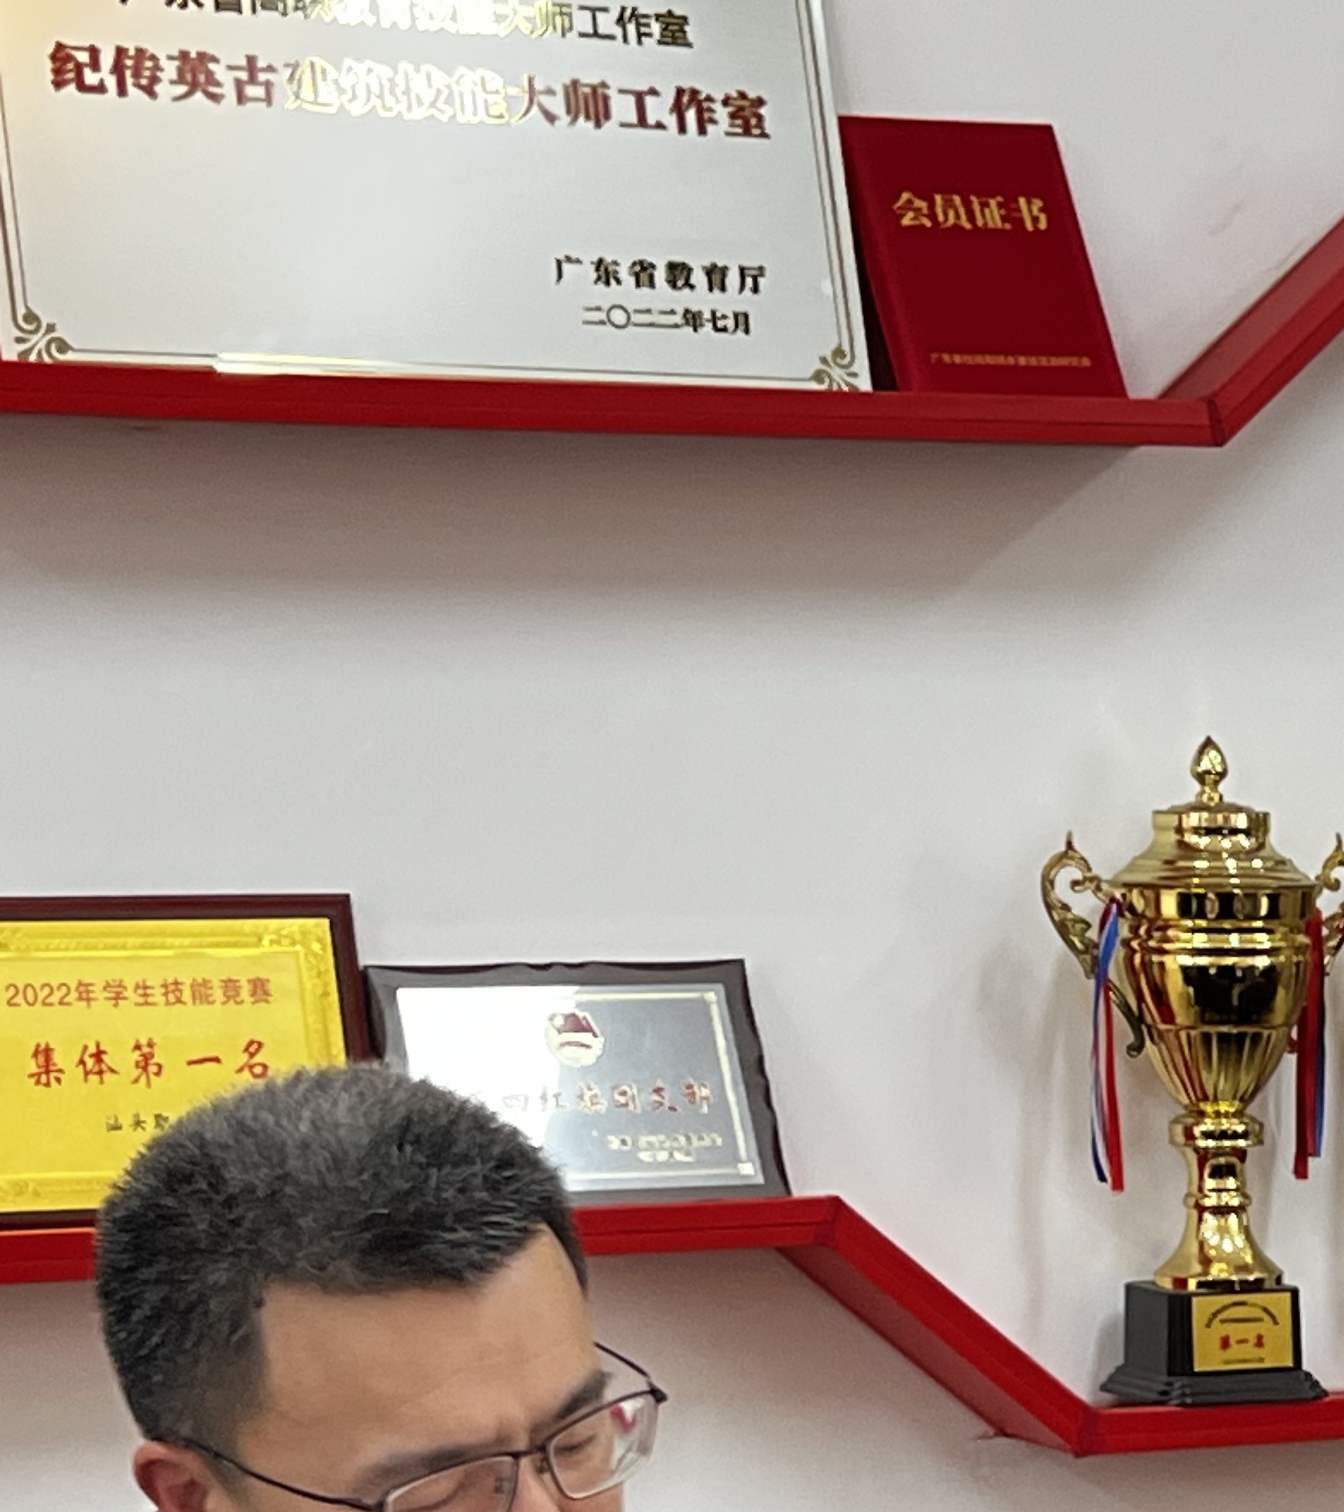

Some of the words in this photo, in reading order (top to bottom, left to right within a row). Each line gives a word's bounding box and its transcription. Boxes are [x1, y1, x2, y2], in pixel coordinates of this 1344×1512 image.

[50, 41, 771, 140] 纪传英古建筑技能大师工作室
[892, 191, 1049, 232] 会员证书
[553, 255, 768, 297] 广东省教育厅
[5, 976, 274, 1009] 2022年学生技能竞赛
[27, 1037, 271, 1089] 集体第一名
